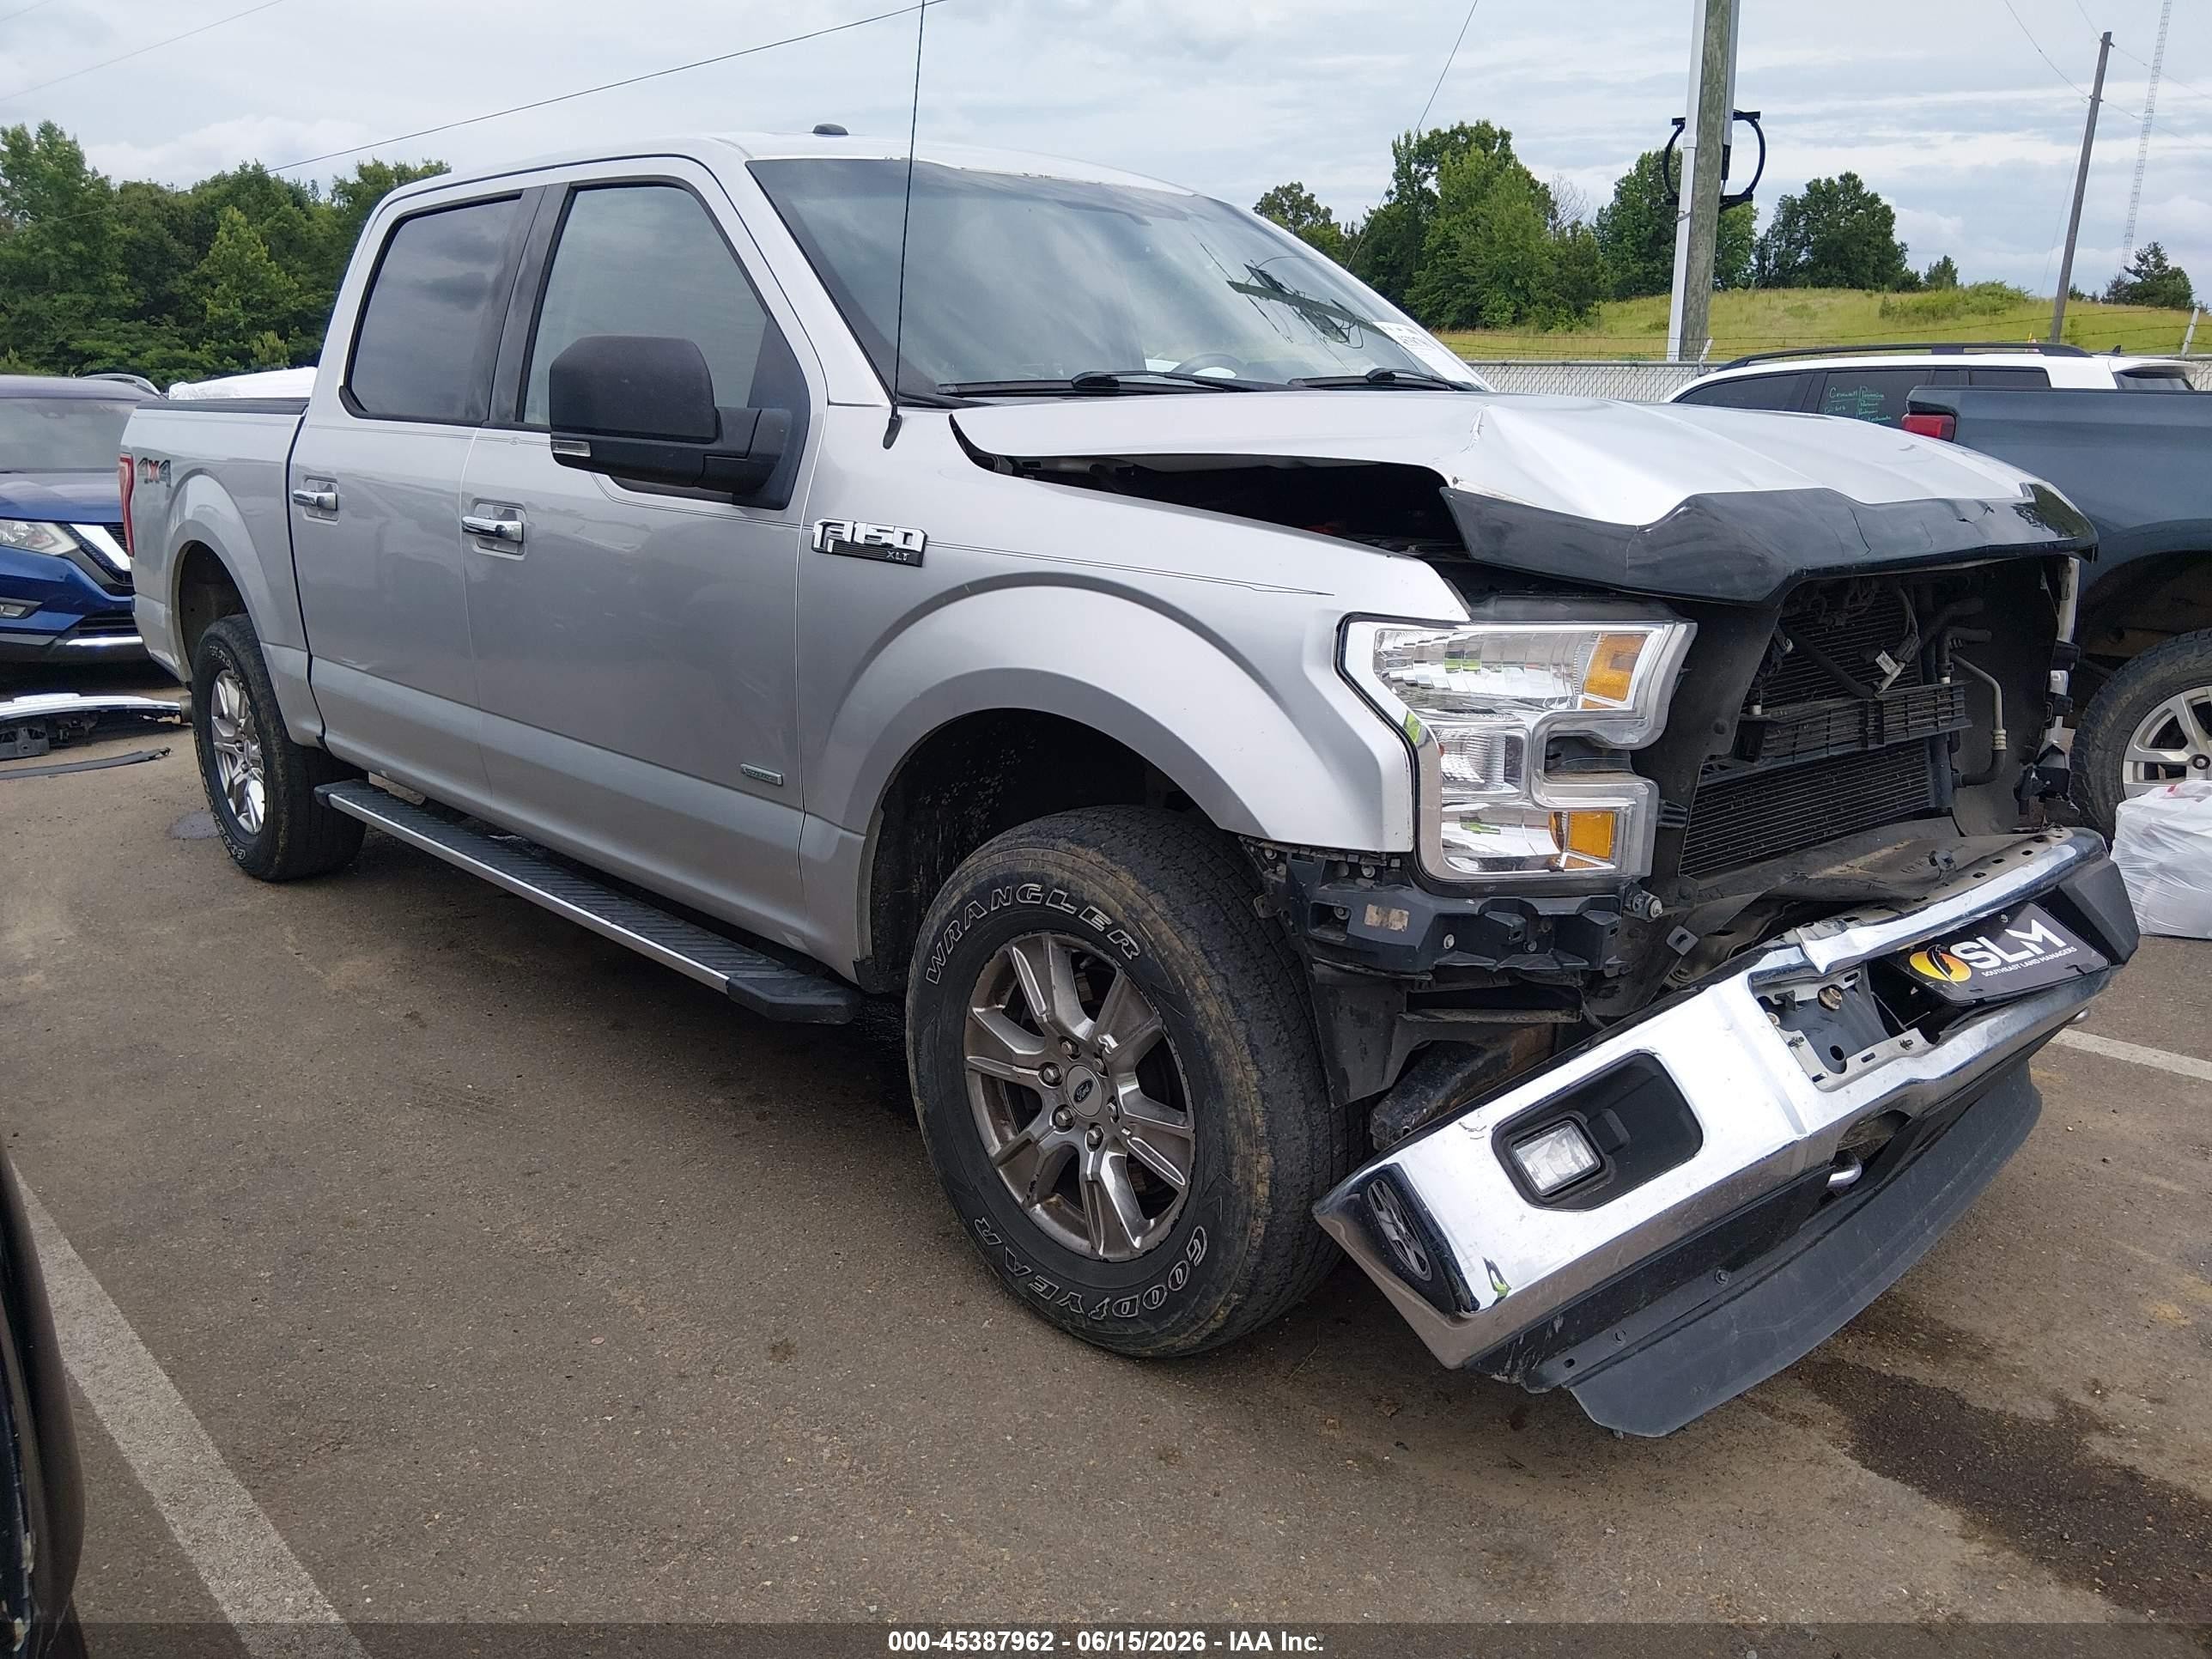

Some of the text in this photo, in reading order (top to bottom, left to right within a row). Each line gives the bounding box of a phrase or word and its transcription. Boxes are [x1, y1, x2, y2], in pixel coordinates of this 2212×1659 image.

[885, 550, 910, 562] XLT
[926, 883, 1141, 985] WRANGLER
[1949, 919, 2068, 969] SLM
[1981, 945, 2078, 977] SOUTHEAST LAND MANAGERS
[1076, 1082, 1091, 1101] Ford
[974, 1215, 1208, 1321] GOODYEAR
